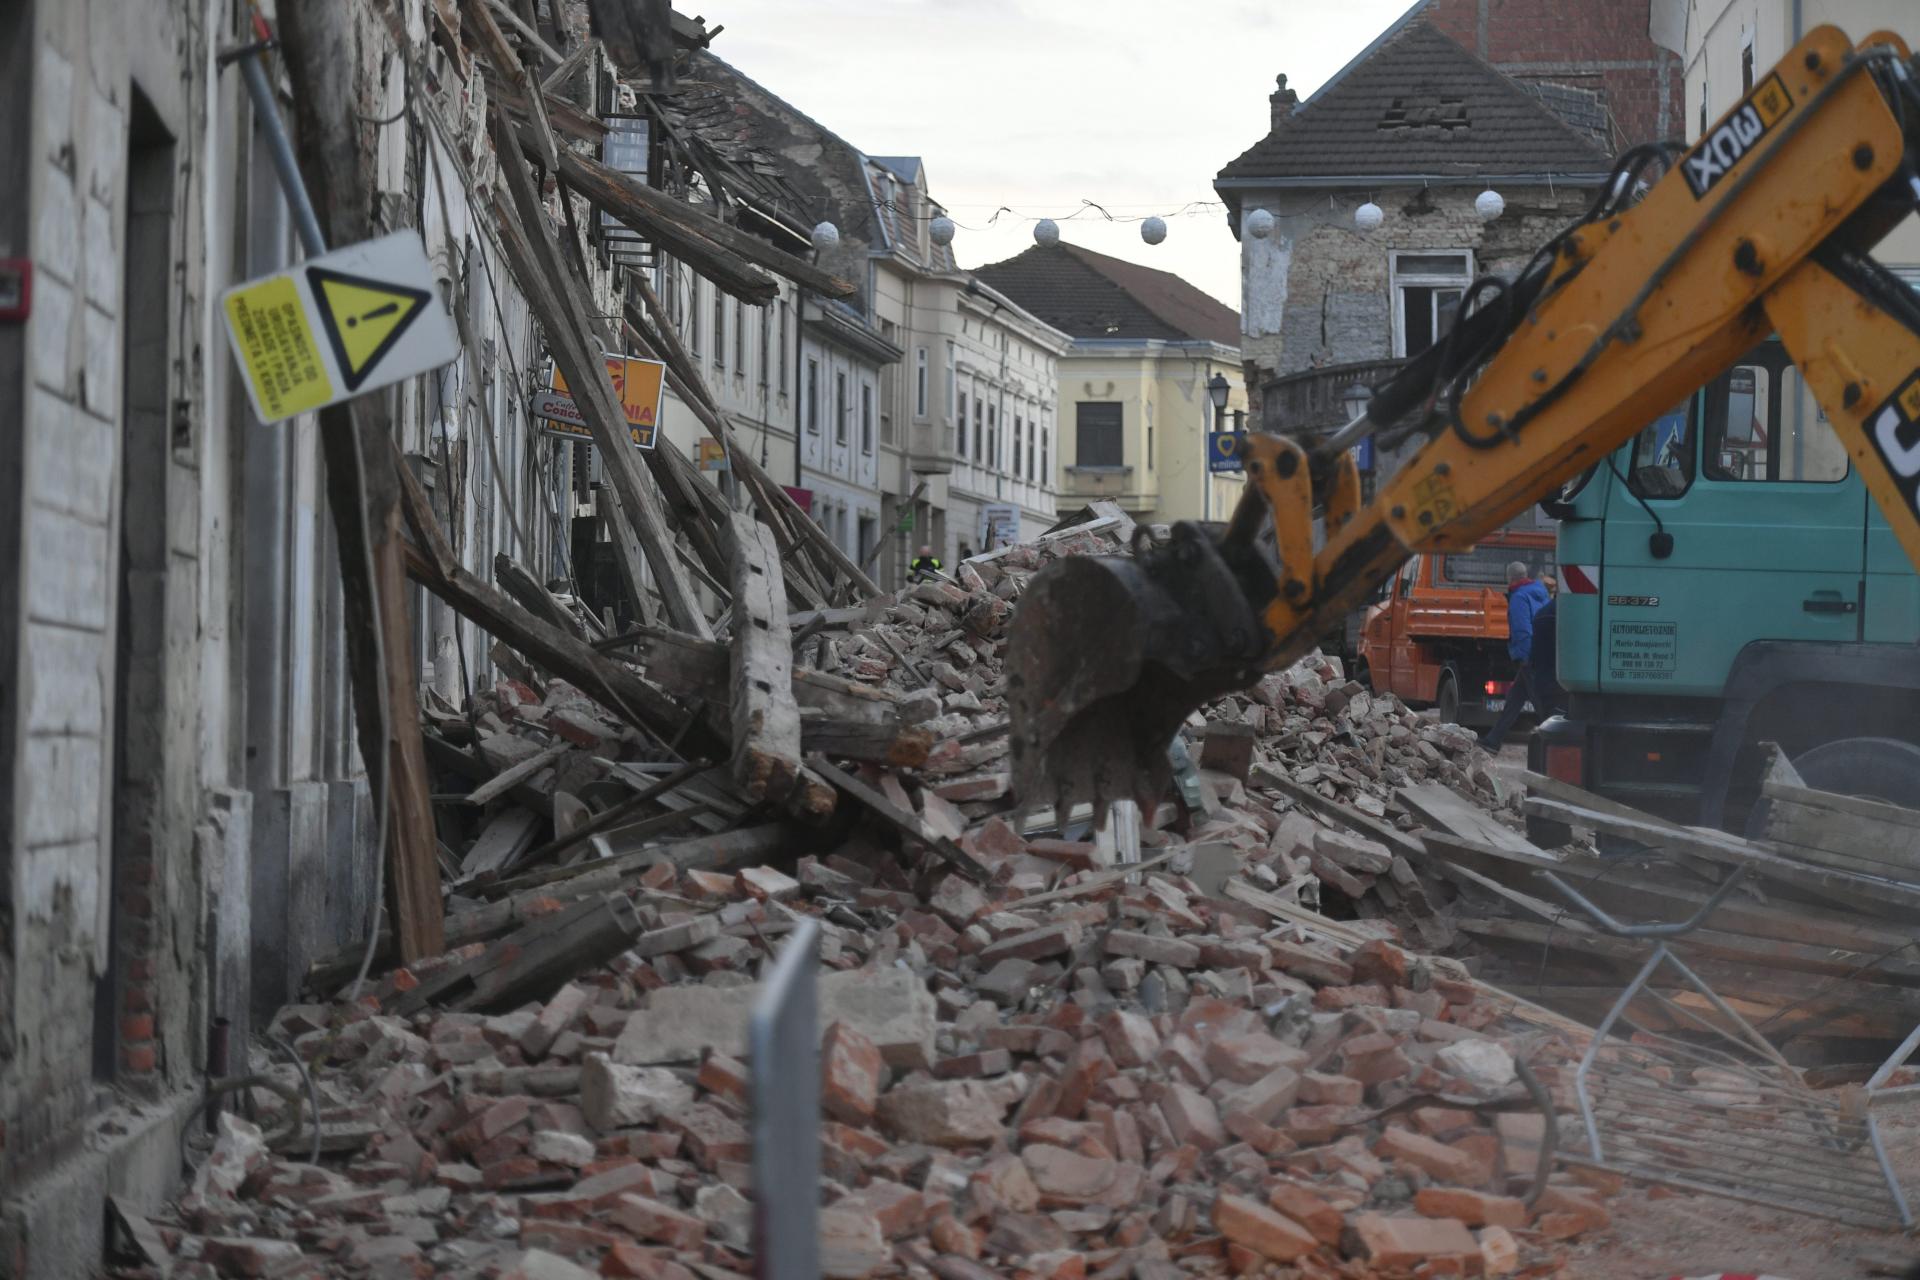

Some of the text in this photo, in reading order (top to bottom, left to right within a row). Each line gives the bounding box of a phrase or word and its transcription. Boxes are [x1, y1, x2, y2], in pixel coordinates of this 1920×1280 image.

[234, 297, 262, 358] PREDMETA
[252, 308, 276, 352] ZGRADE
[273, 361, 290, 394] PADA
[268, 307, 302, 385] URUŠAVANJA
[282, 303, 318, 381] OPASNOST OD
[543, 402, 582, 420] Conco
[1218, 461, 1242, 469] mlina
